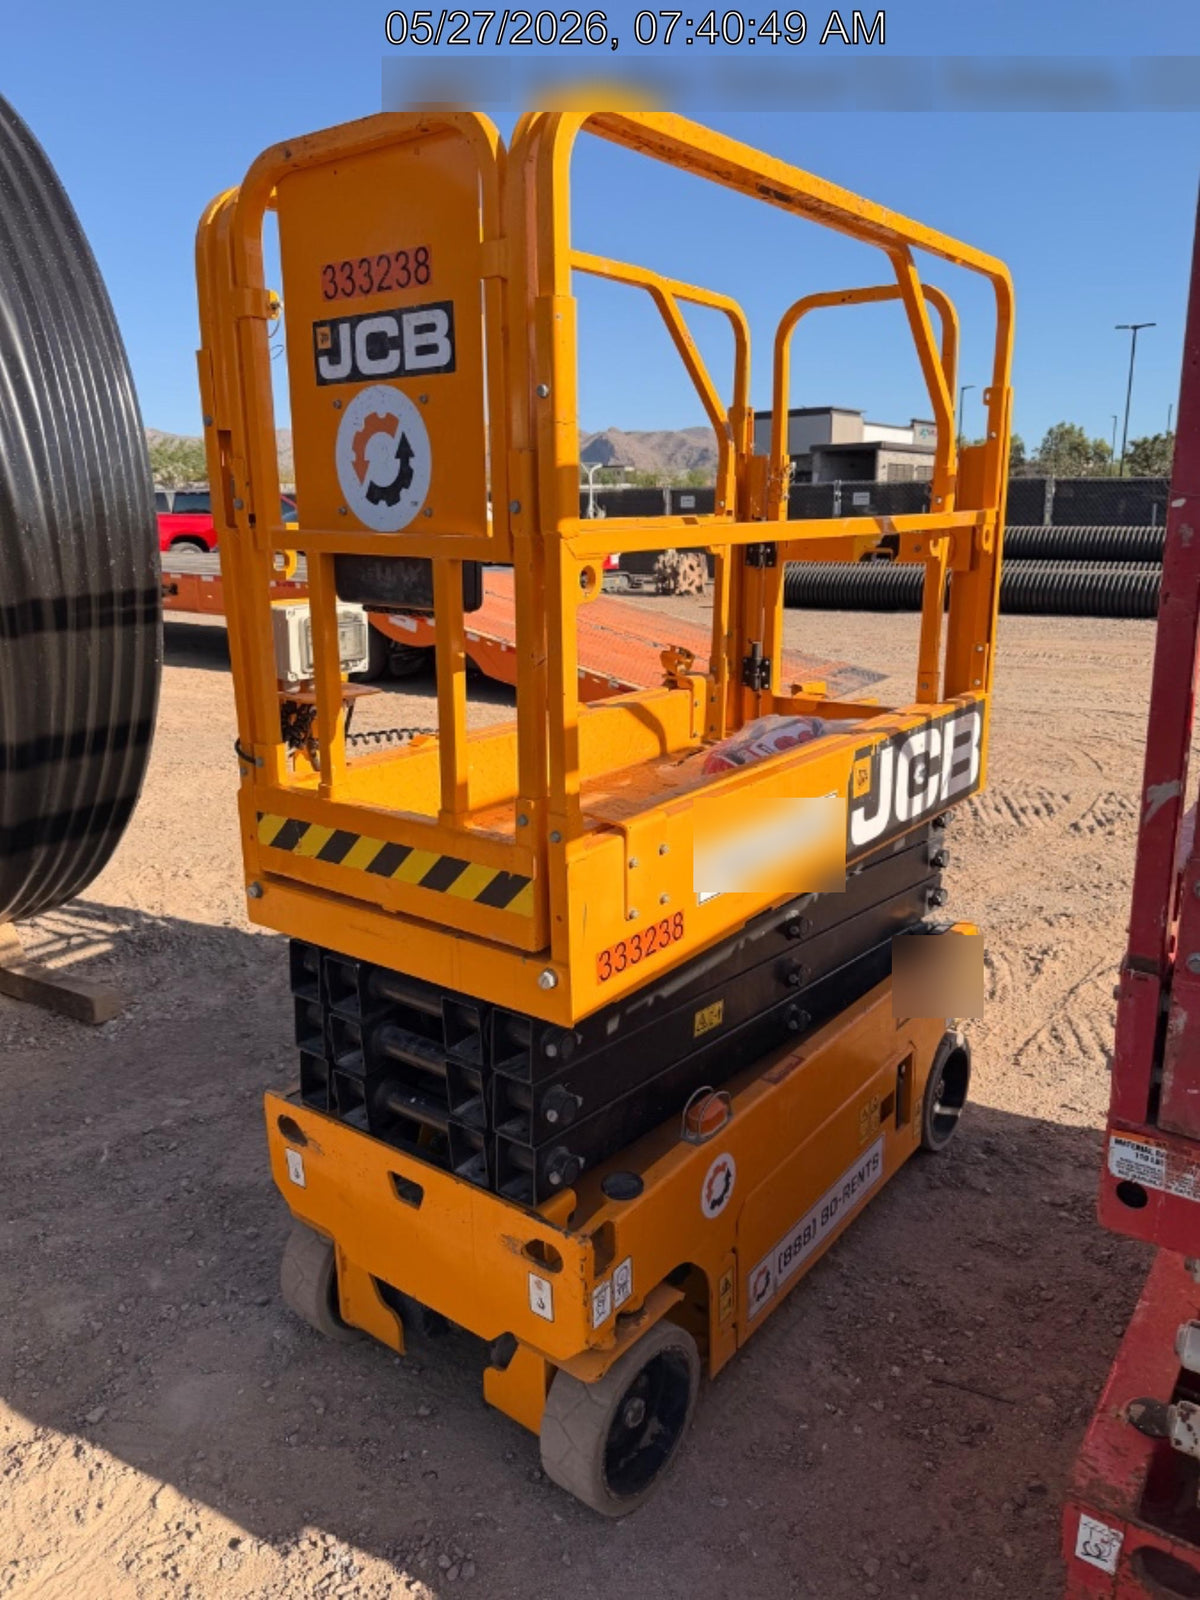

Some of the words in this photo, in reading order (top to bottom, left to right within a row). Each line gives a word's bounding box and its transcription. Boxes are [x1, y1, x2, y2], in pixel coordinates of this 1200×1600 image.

[322, 246, 431, 300] 333238
[317, 308, 452, 380] JCB
[851, 711, 981, 846] JCB
[598, 911, 684, 982] 333238
[777, 1217, 818, 1275] (888)
